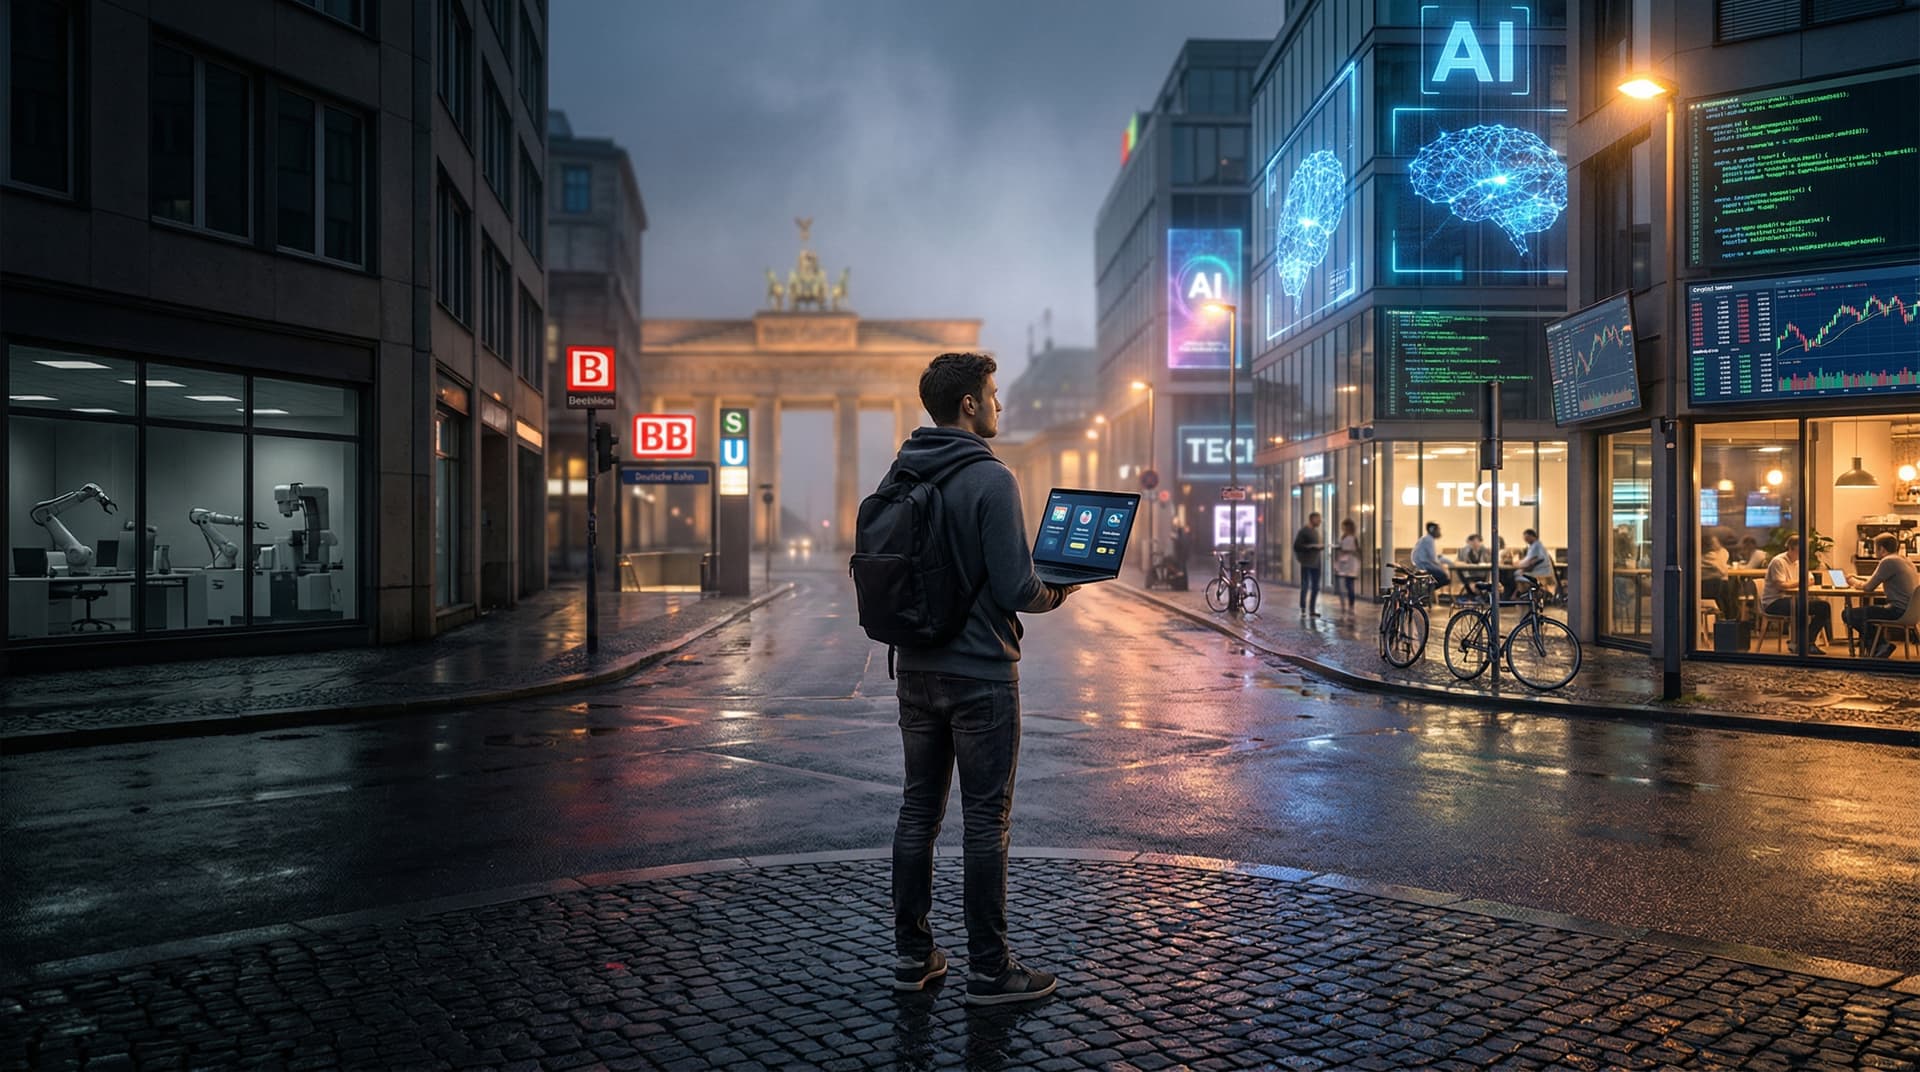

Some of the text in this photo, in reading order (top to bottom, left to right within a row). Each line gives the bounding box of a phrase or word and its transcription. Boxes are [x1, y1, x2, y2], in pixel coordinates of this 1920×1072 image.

[1431, 21, 1514, 82] AI
[1187, 272, 1222, 298] AI
[579, 354, 602, 383] B
[725, 411, 743, 433] S
[641, 422, 688, 450] BB
[724, 440, 744, 465] U
[1436, 482, 1520, 507] TECH
